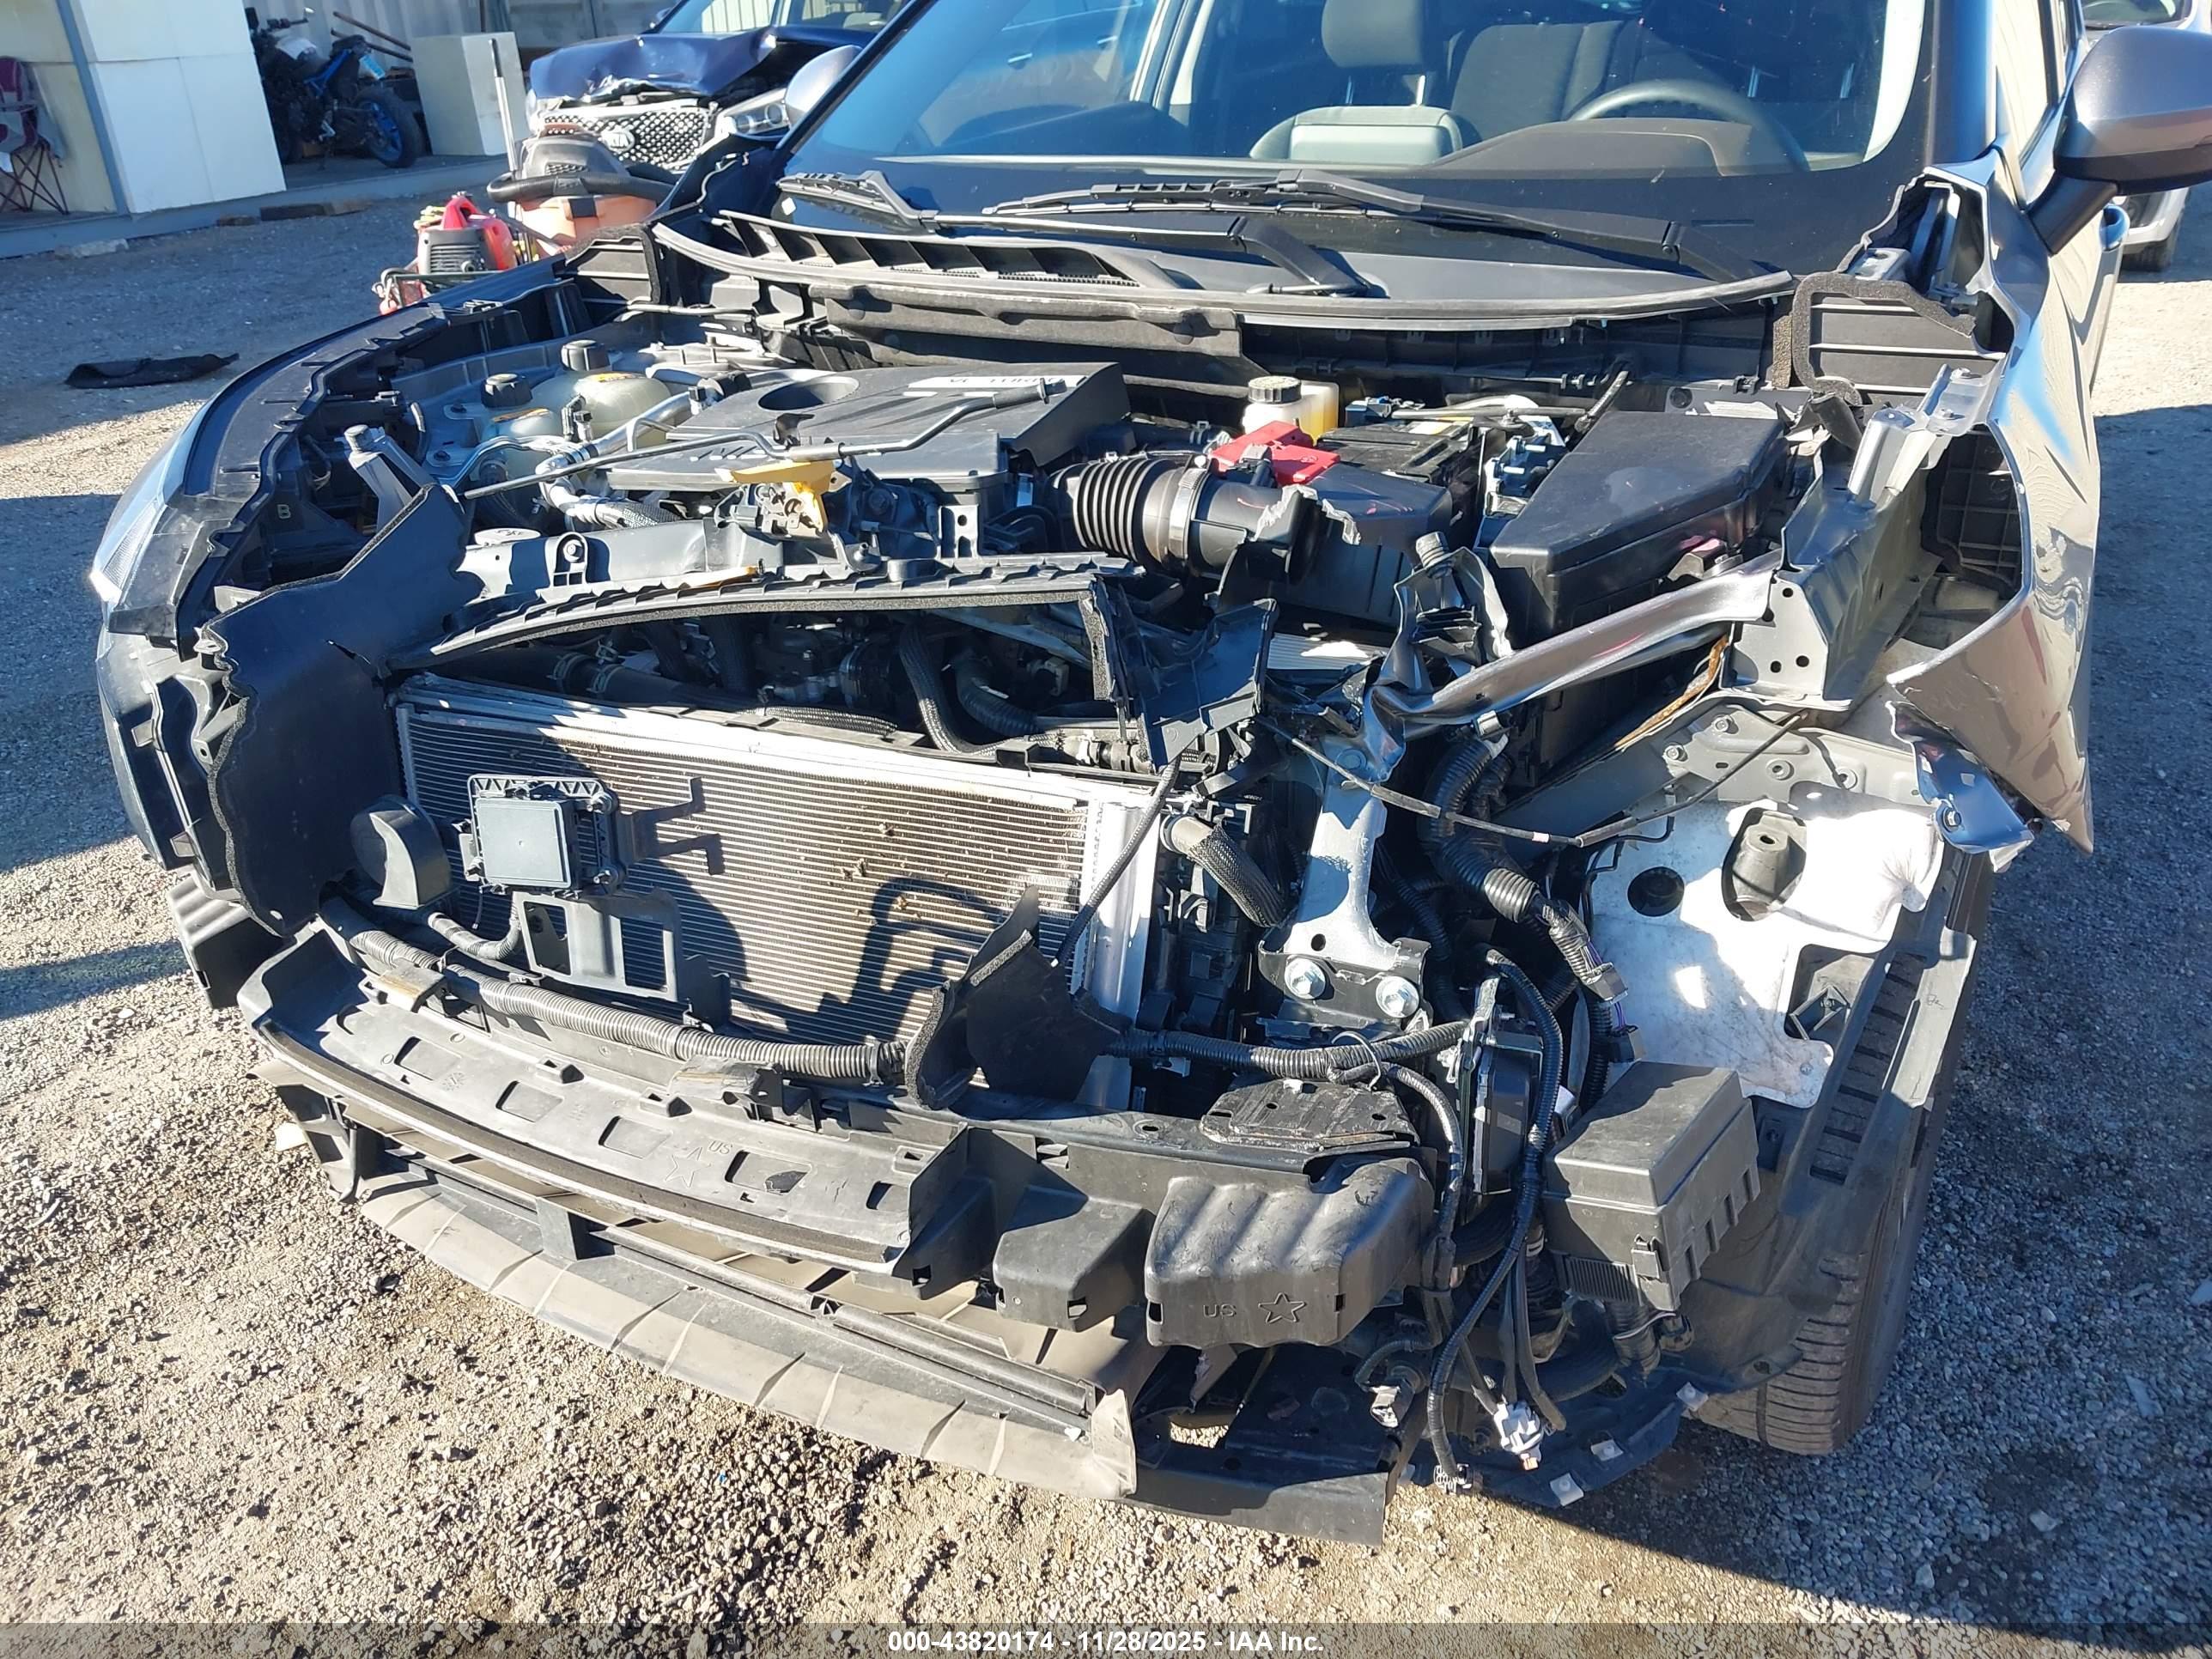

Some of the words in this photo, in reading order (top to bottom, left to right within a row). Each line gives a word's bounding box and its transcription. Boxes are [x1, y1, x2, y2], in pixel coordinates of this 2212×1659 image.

[276, 503, 291, 520] B
[708, 1139, 732, 1155] US
[1202, 1303, 1237, 1319] US
